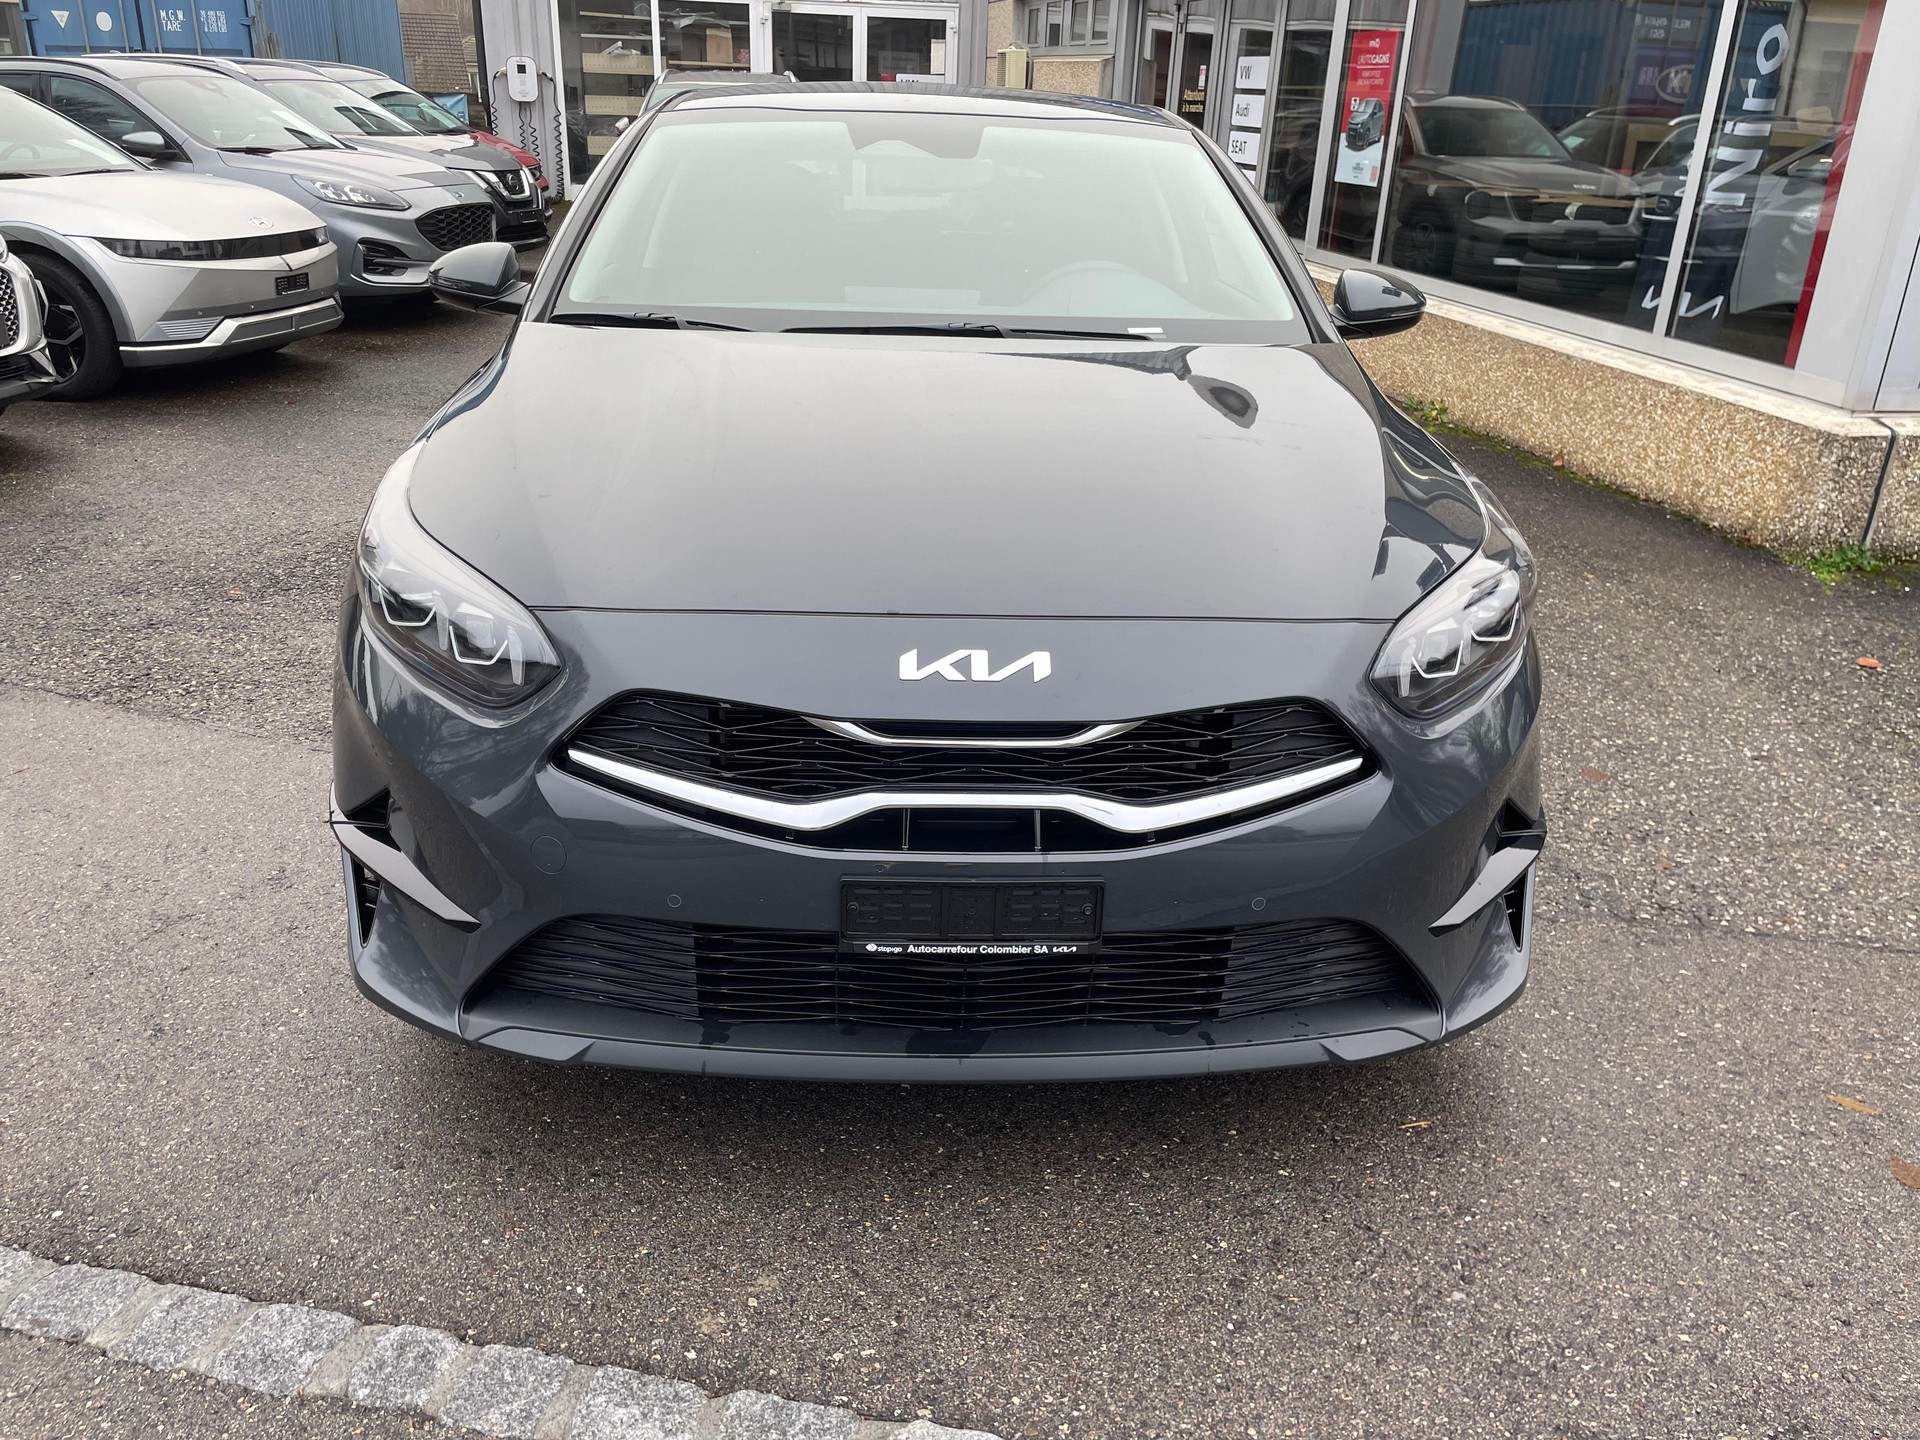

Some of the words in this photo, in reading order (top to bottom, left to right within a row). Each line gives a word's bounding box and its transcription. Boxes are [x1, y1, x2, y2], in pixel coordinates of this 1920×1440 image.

[160, 9, 186, 21] M.G.W.
[162, 20, 182, 32] TARE
[1240, 65, 1253, 80] VW
[1235, 103, 1251, 118] Audi
[1706, 23, 1791, 207] Niro
[1231, 139, 1248, 155] SEAT
[899, 648, 1052, 683] KIA
[907, 944, 977, 954] Autocarrefour
[979, 945, 1032, 954] Colombier
[1033, 945, 1049, 954] SA
